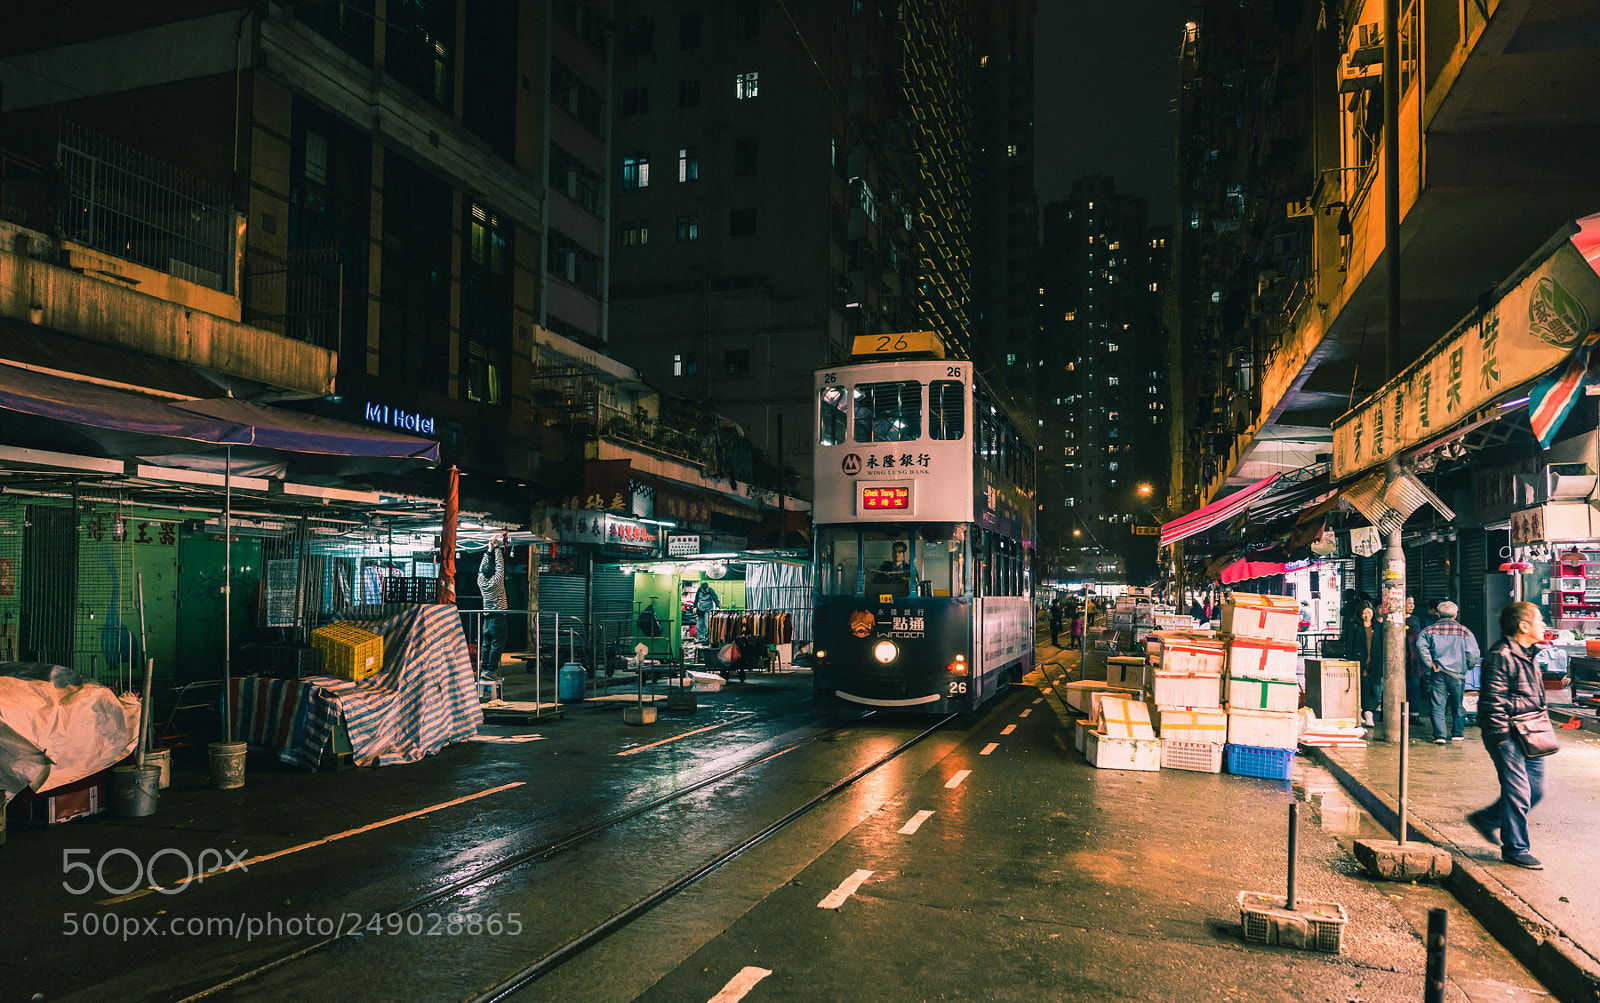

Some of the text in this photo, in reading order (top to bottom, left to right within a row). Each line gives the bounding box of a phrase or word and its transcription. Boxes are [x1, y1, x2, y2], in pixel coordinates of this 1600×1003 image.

[875, 335, 909, 351] 26
[946, 366, 961, 378] 26
[824, 373, 837, 384] 26
[394, 408, 434, 434] Hotel
[866, 453, 931, 469] 永隆銀行
[864, 488, 908, 498] Shek Tong Tsui
[877, 608, 925, 616] 永隆銀行
[877, 616, 925, 631] 一點通
[950, 682, 967, 694] 26
